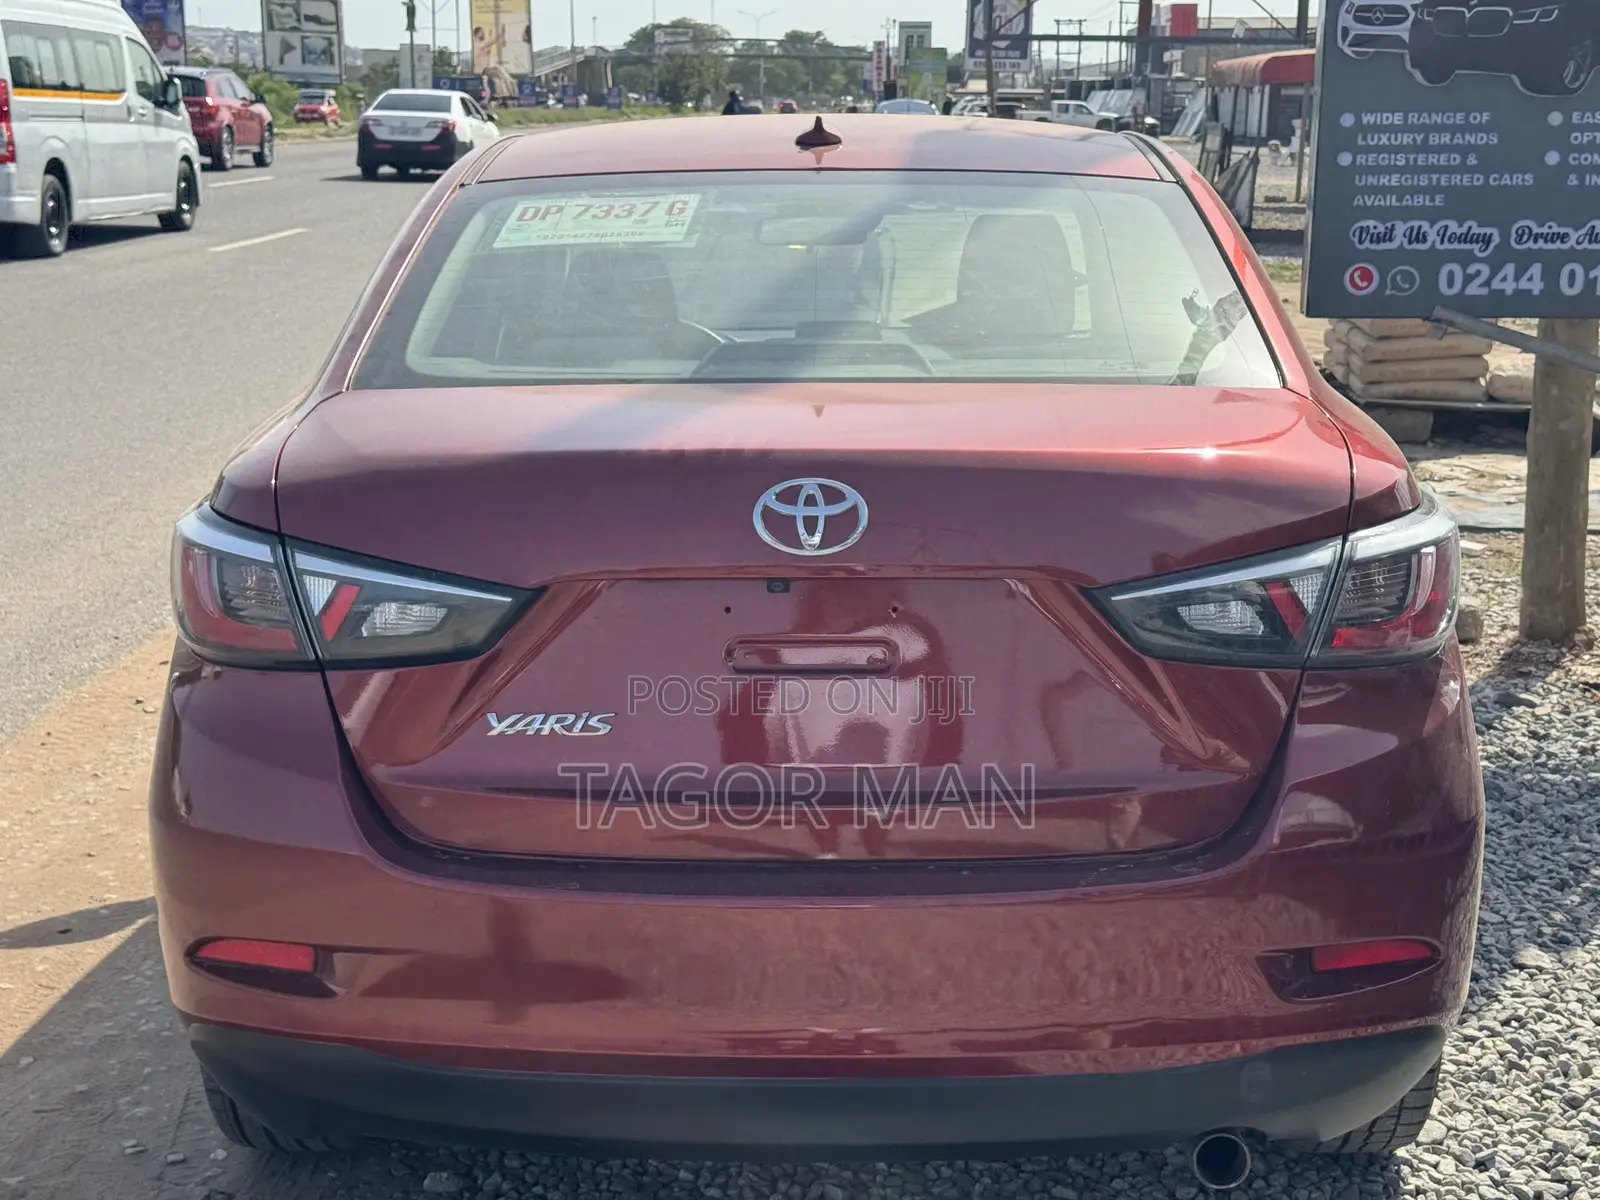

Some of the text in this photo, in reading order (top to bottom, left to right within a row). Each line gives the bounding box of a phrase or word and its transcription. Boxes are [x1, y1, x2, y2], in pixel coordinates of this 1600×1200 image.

[1361, 112, 1491, 125] WIDE RANGE OF
[1357, 132, 1499, 146] LUXURY BRANDS
[1356, 152, 1478, 167] REGISTERED &
[1354, 173, 1534, 187] UNREGISTERED CARS
[1566, 173, 1579, 186] &
[1352, 194, 1446, 207] AVAILABLE
[516, 200, 688, 222] DP 7337 G
[1352, 222, 1397, 246] Visit
[1403, 224, 1428, 246] Us
[1436, 224, 1494, 253] Today
[1514, 224, 1571, 246] Drive
[1438, 262, 1600, 296] 0244 01
[486, 711, 614, 737] YARIS
